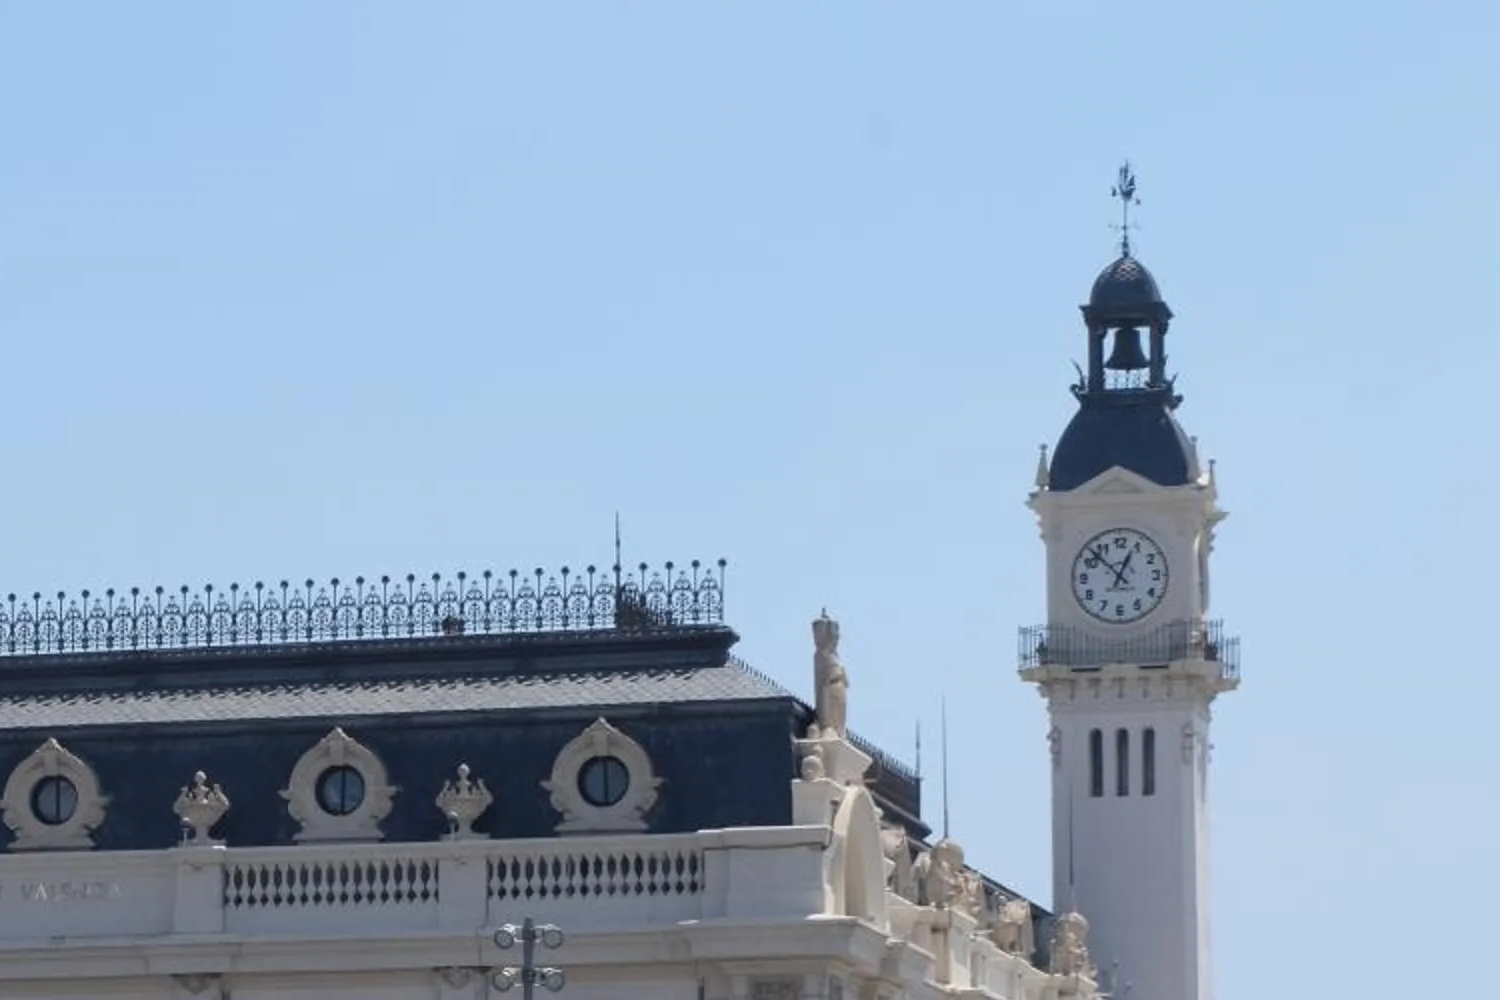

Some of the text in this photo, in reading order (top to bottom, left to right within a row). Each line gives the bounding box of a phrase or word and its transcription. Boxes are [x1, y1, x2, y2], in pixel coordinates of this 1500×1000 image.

[1114, 537, 1127, 549] 12
[1147, 553, 1155, 565] 2
[1152, 569, 1160, 581] 3
[1147, 587, 1155, 598] 4
[1100, 599, 1109, 612] 7
[1133, 598, 1142, 611] 5
